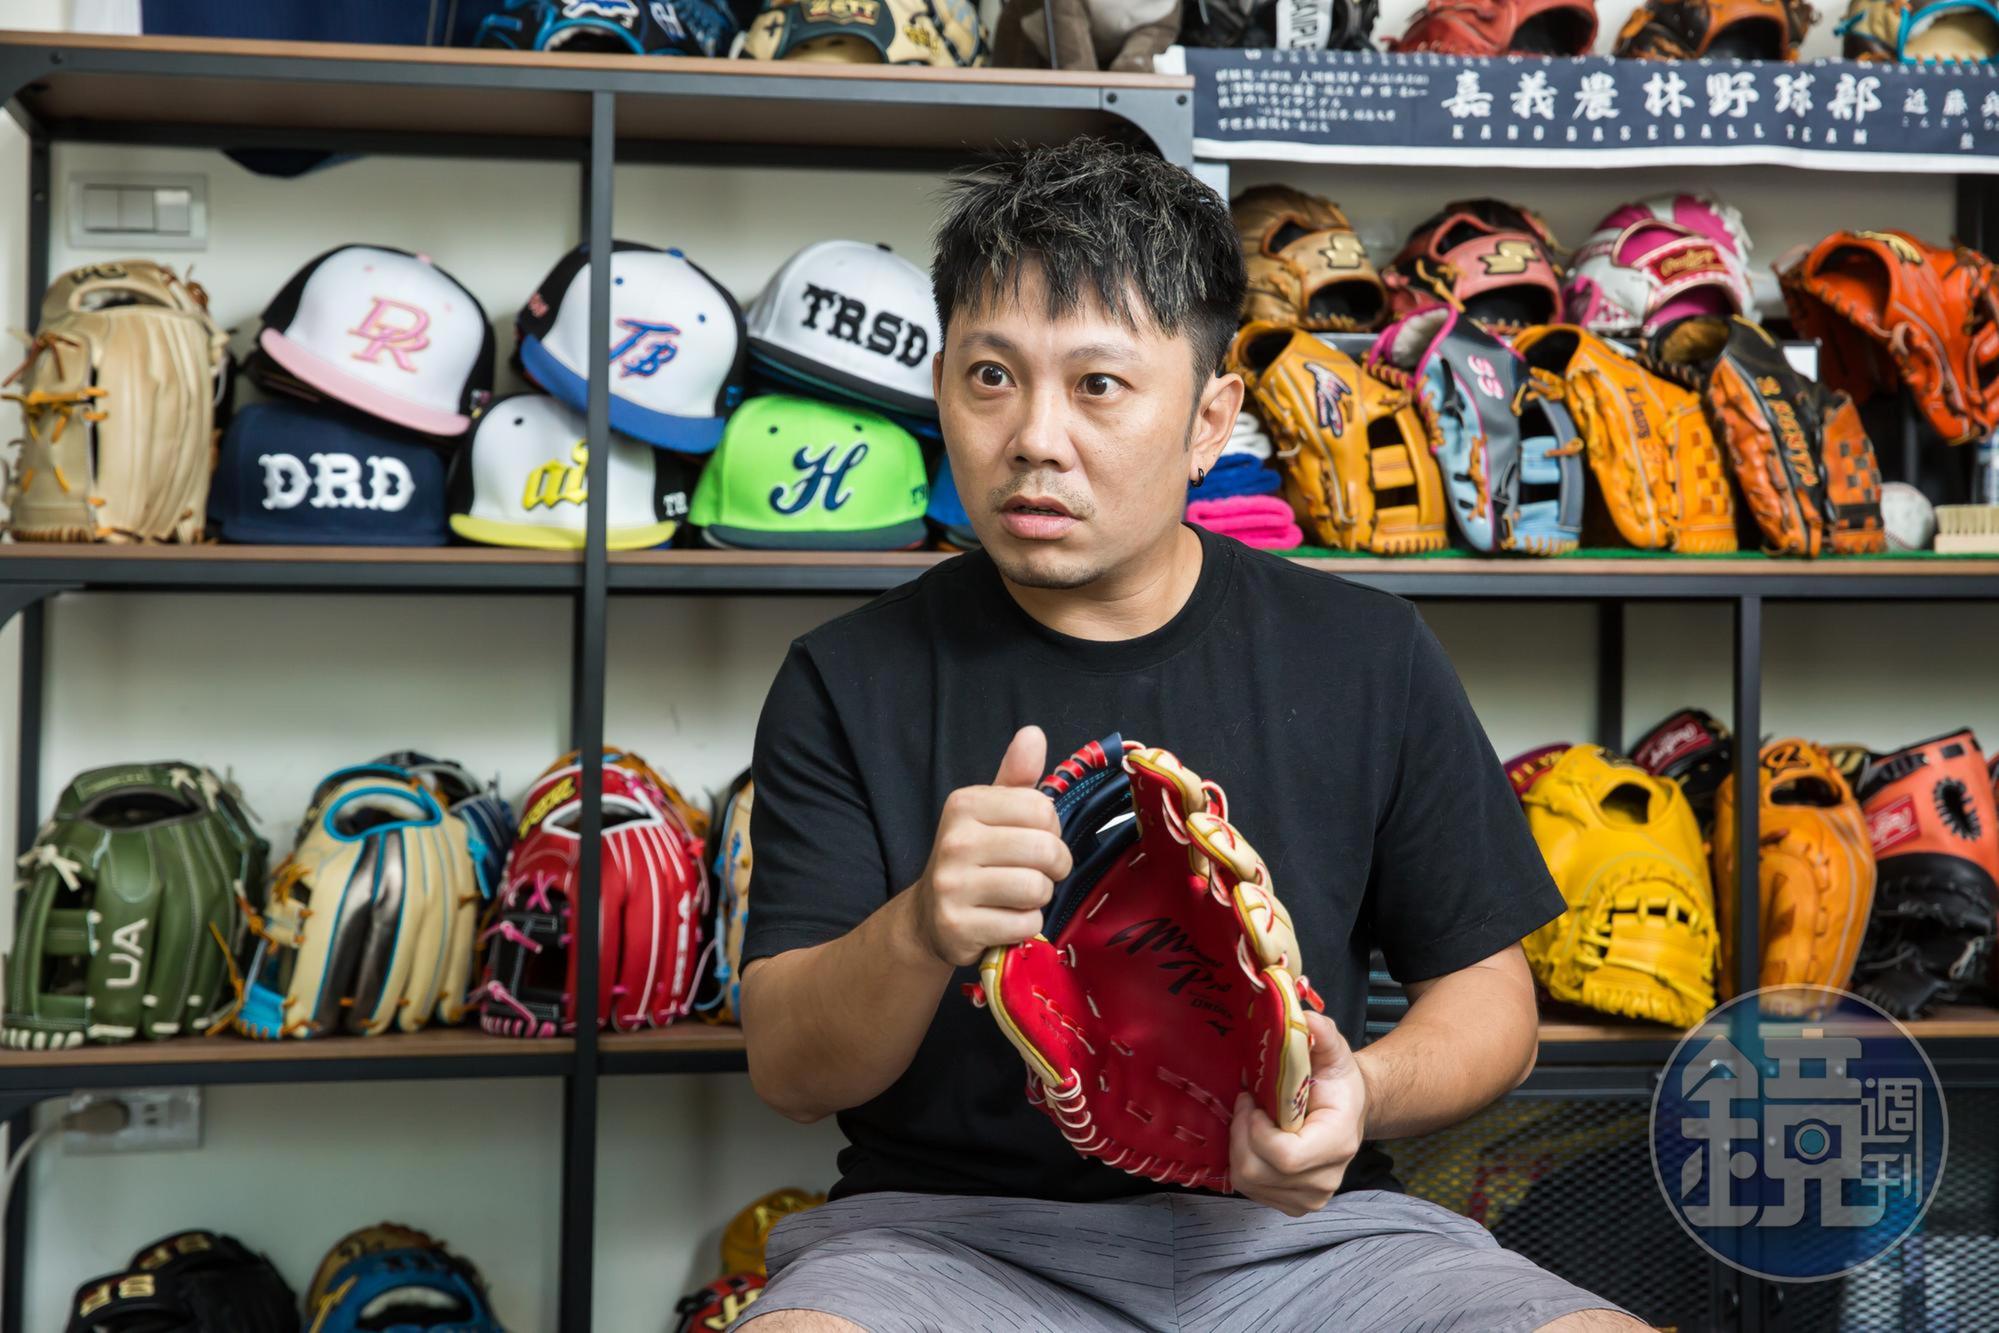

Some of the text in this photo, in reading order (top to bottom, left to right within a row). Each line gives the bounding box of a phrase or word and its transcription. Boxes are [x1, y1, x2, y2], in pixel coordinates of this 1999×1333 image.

[1441, 69, 1882, 122] 嘉義農林野球部
[1566, 122, 1765, 142] BASEBALL
[1786, 123, 1867, 144] TEAM
[801, 282, 930, 369] TRSD
[258, 452, 416, 512] DRD
[767, 442, 869, 516] H
[106, 917, 150, 988] UA
